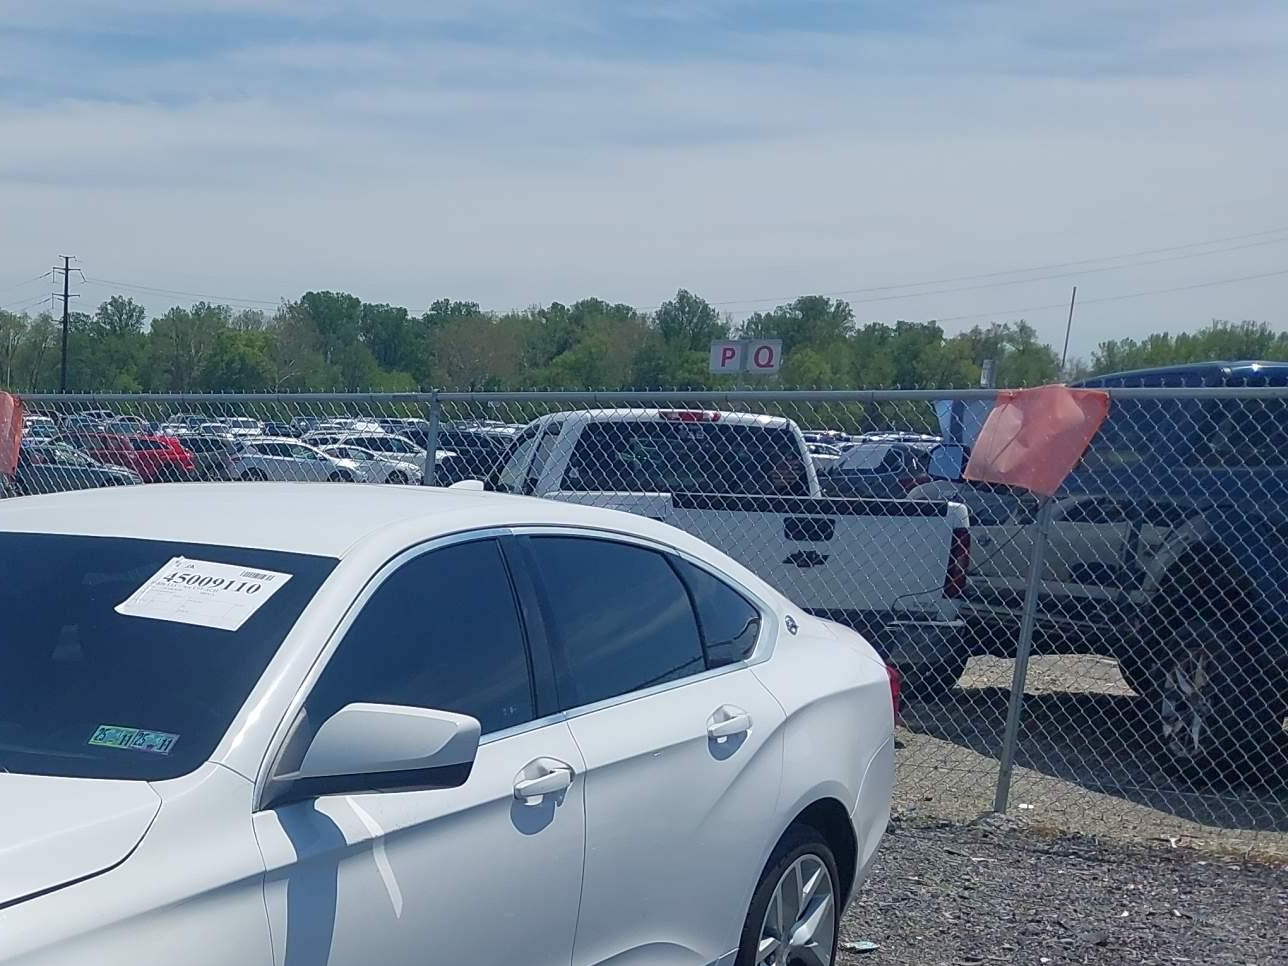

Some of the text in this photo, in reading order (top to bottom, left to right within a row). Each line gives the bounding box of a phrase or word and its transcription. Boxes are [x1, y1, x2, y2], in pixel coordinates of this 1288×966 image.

[721, 345, 775, 368] P Q
[162, 571, 262, 595] 45009110
